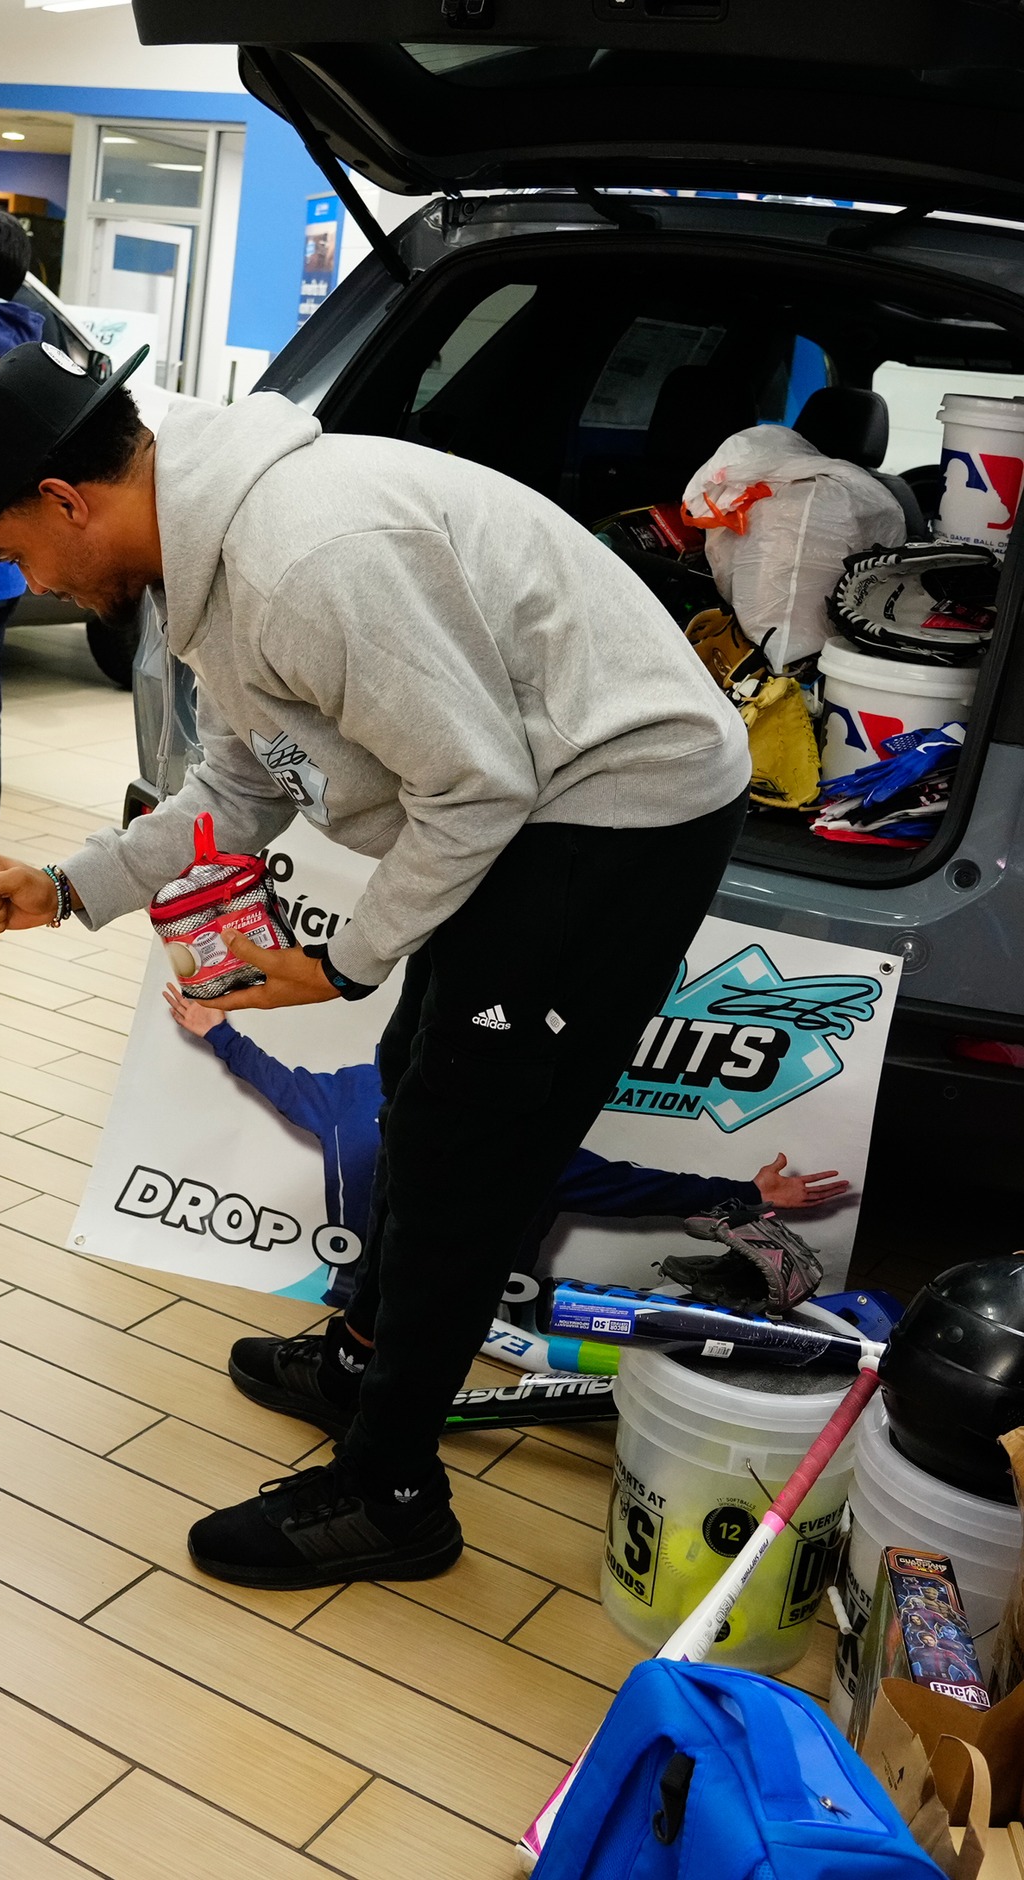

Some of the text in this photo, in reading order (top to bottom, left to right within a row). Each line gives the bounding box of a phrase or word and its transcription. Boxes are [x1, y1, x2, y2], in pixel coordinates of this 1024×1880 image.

[950, 534, 970, 543] GAME
[973, 538, 994, 547] BALL
[240, 910, 262, 922] T-BALL
[471, 1015, 511, 1030] adidas
[114, 1164, 302, 1252] DROP
[616, 1454, 667, 1510] STARTS AT
[727, 1497, 757, 1511] SOFTBALLS
[799, 1510, 838, 1534] EVERY
[719, 1522, 742, 1542] 12
[606, 1545, 646, 1597] GOODS
[933, 1683, 965, 1698] EPIC
